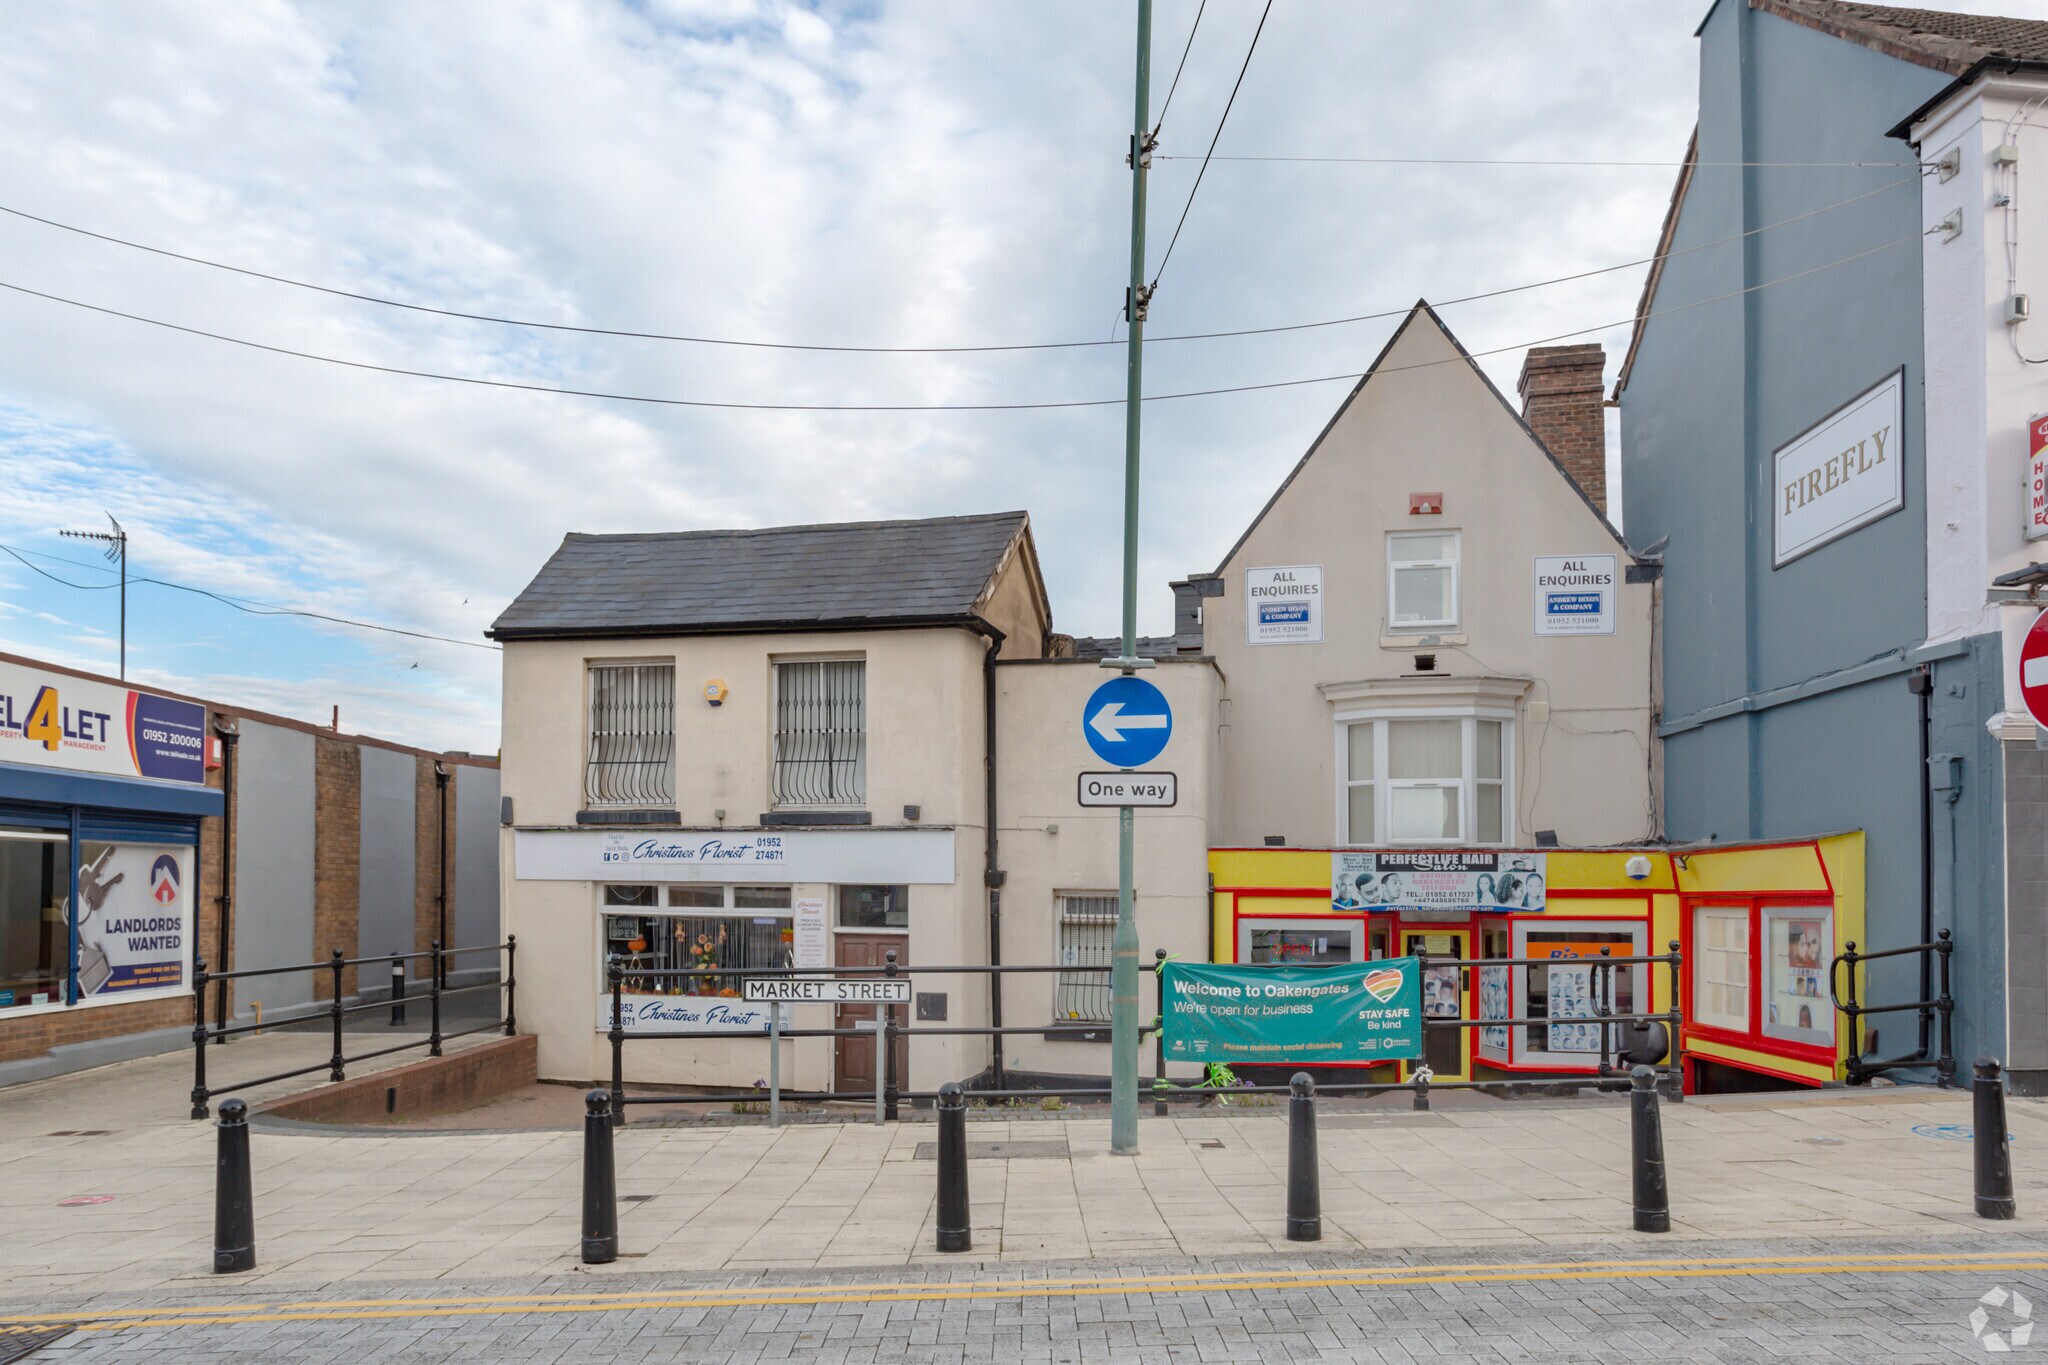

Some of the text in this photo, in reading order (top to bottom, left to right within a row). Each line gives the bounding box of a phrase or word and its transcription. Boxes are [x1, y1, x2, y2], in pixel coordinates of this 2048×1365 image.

[1784, 425, 1890, 516] FIREFLY
[1562, 561, 1587, 571] ALL
[1273, 572, 1296, 582] ALL
[1539, 574, 1611, 587] ENQUIRIES
[1251, 584, 1318, 597] ENQUIRIES
[1260, 605, 1287, 613] ANDREW
[143, 729, 202, 749] 01952 200006
[63, 740, 106, 752] MANAGEMENT
[1088, 781, 1167, 799] One way
[757, 837, 781, 847] 01952
[632, 839, 753, 860] Christines Florist
[755, 850, 783, 860] 274871
[1381, 854, 1459, 865] PERFECTLIFE
[1461, 854, 1494, 865] HAIR
[1413, 856, 1469, 871] Salon
[105, 917, 182, 934] LANDLORDS
[611, 929, 638, 938] OPEN
[127, 935, 182, 952] WANTED
[1271, 943, 1311, 956] OPEN
[750, 982, 905, 999] MARKET STREET
[1173, 980, 1349, 999] Welcome to Oakengates
[610, 1003, 633, 1013] 0952
[638, 1000, 761, 1025] Christines Florist
[1173, 1001, 1314, 1017] We're open for business
[1359, 1008, 1410, 1019] STAY SAFE
[609, 1016, 635, 1026] 2871
[1367, 1020, 1402, 1030] Be kind
[1223, 1041, 1343, 1051] Please maintain social distancing
